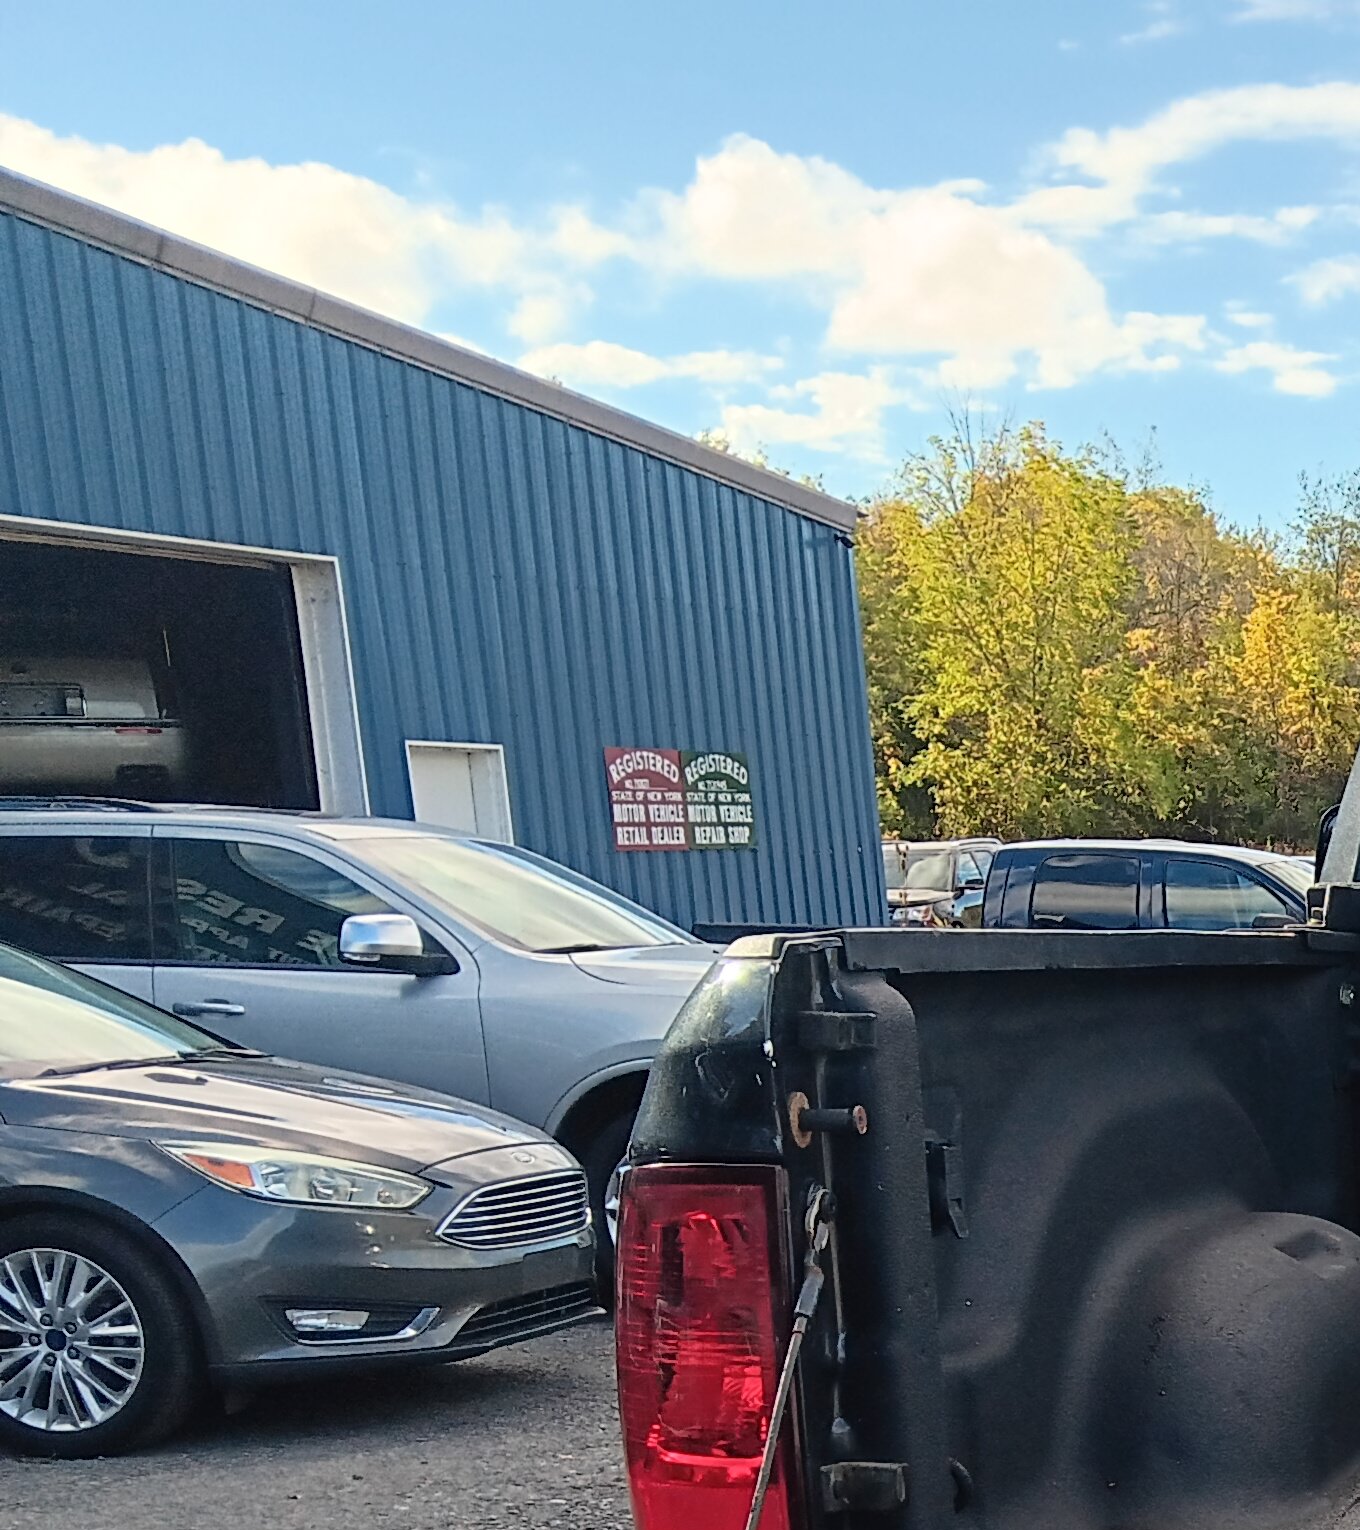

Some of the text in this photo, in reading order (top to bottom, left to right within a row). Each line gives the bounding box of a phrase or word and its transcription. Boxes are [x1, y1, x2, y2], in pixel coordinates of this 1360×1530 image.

[609, 751, 679, 784] REGISTERED
[685, 754, 748, 785] REGISTERED
[613, 804, 685, 823] MOTOR VEHICLE
[687, 805, 753, 823] MOTOR VEHICLE
[617, 826, 685, 845] RETAIL DEALER
[695, 826, 750, 844] REPAIR SHOP
